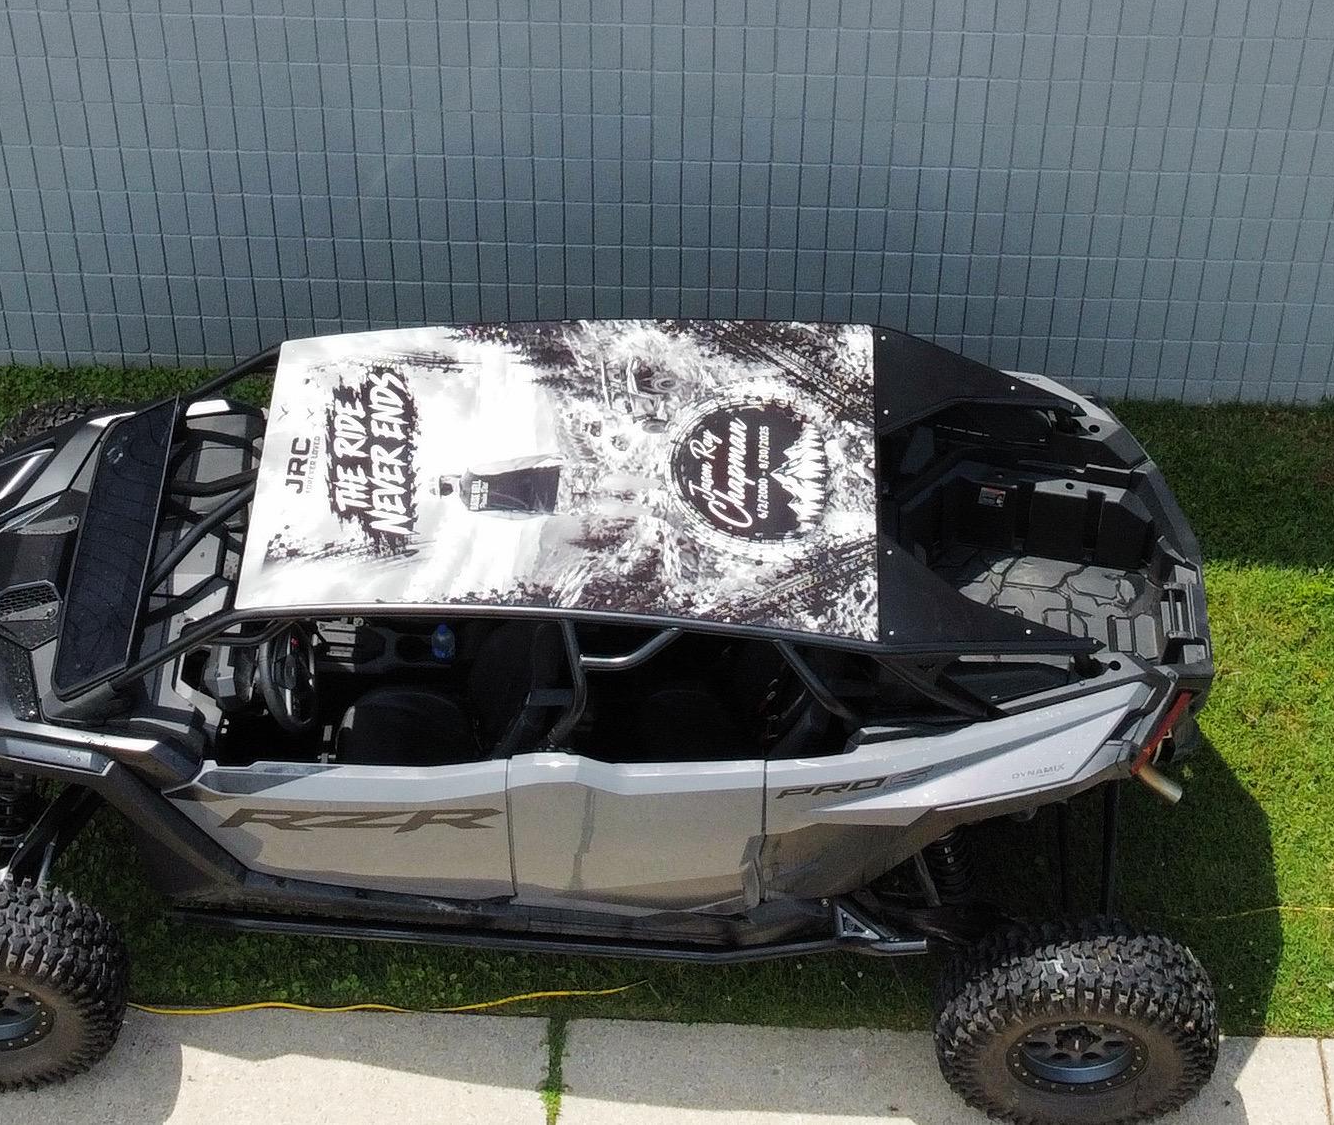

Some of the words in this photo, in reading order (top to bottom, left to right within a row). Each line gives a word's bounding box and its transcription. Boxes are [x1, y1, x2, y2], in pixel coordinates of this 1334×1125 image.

[333, 397, 370, 458] RIDE
[367, 373, 414, 440] ENDS
[285, 437, 311, 494] JRC
[689, 429, 723, 460] Ray
[333, 464, 372, 511] THE
[365, 444, 420, 535] NEVER
[688, 461, 716, 501] Jason
[707, 417, 756, 528] Chapman
[775, 775, 888, 800] PRO
[1011, 762, 1066, 780] DYNAMIX
[218, 807, 506, 835] RZR
